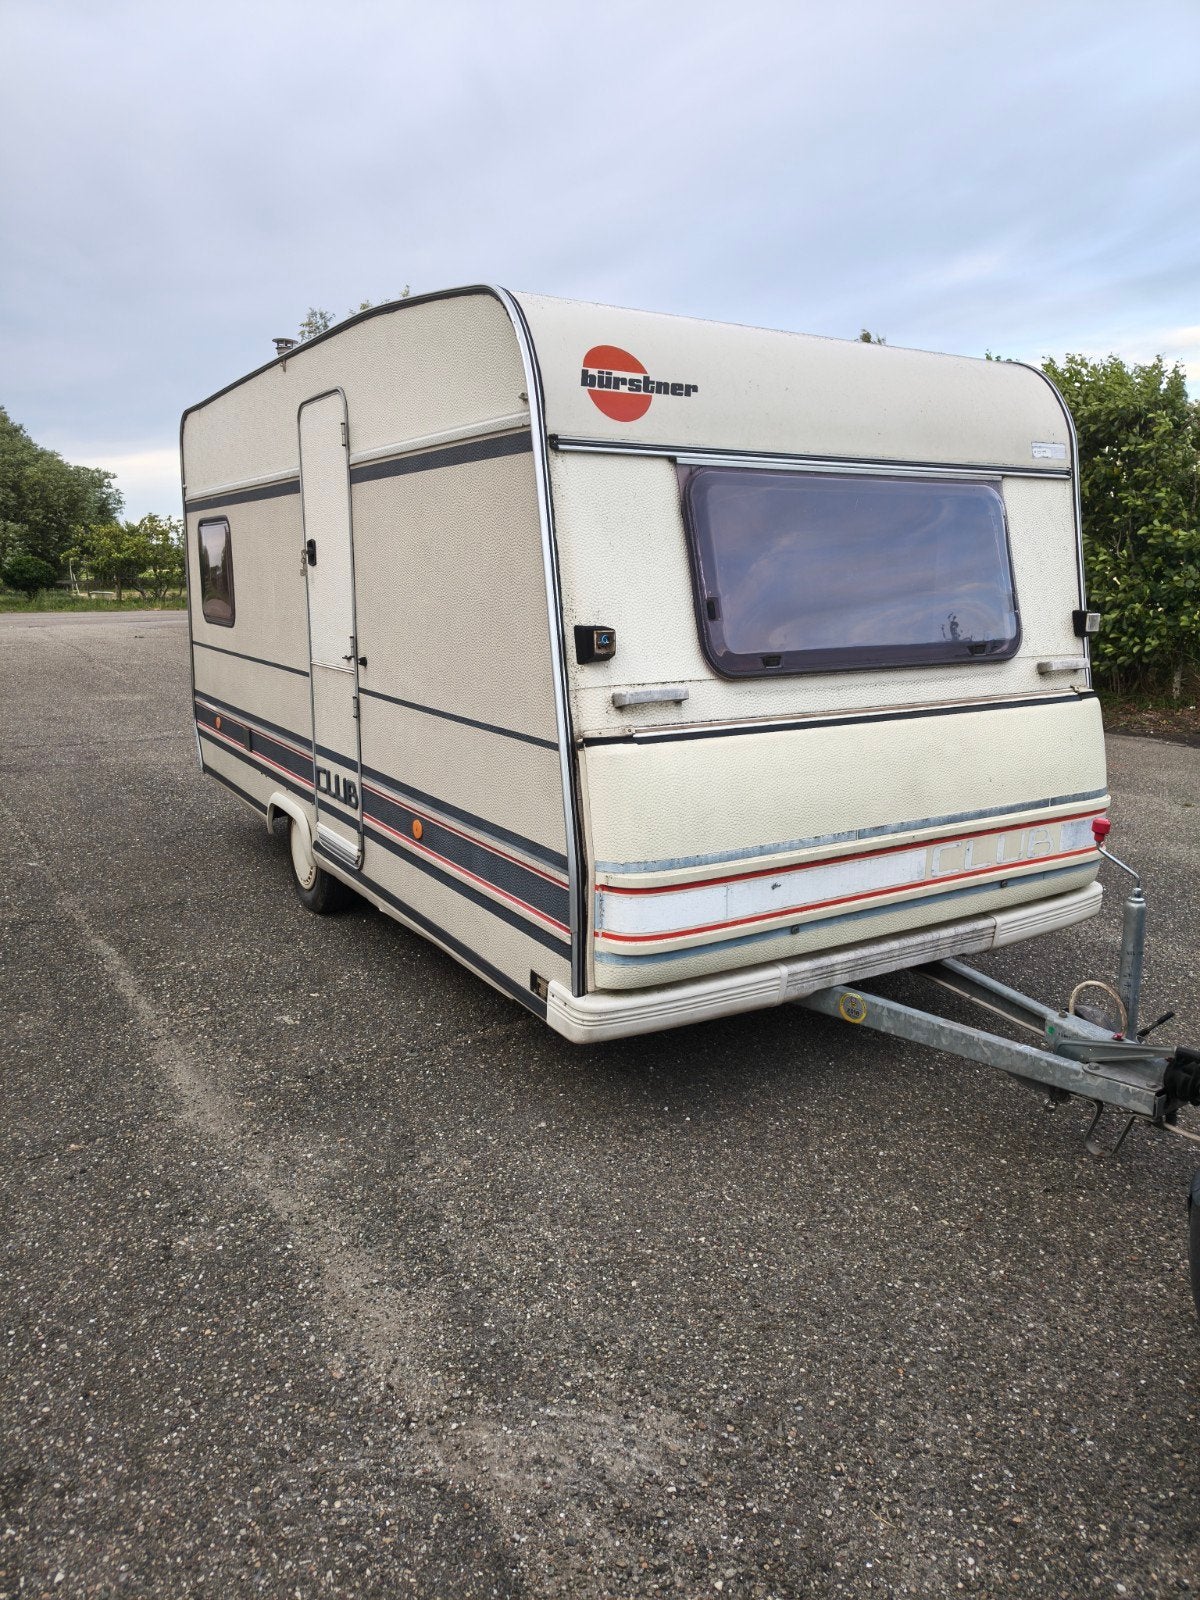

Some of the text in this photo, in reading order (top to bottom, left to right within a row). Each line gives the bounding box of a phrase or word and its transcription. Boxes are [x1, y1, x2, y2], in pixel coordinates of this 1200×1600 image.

[581, 369, 698, 397] bürstner
[316, 766, 358, 810] CLUB
[931, 828, 1053, 877] CLUB
